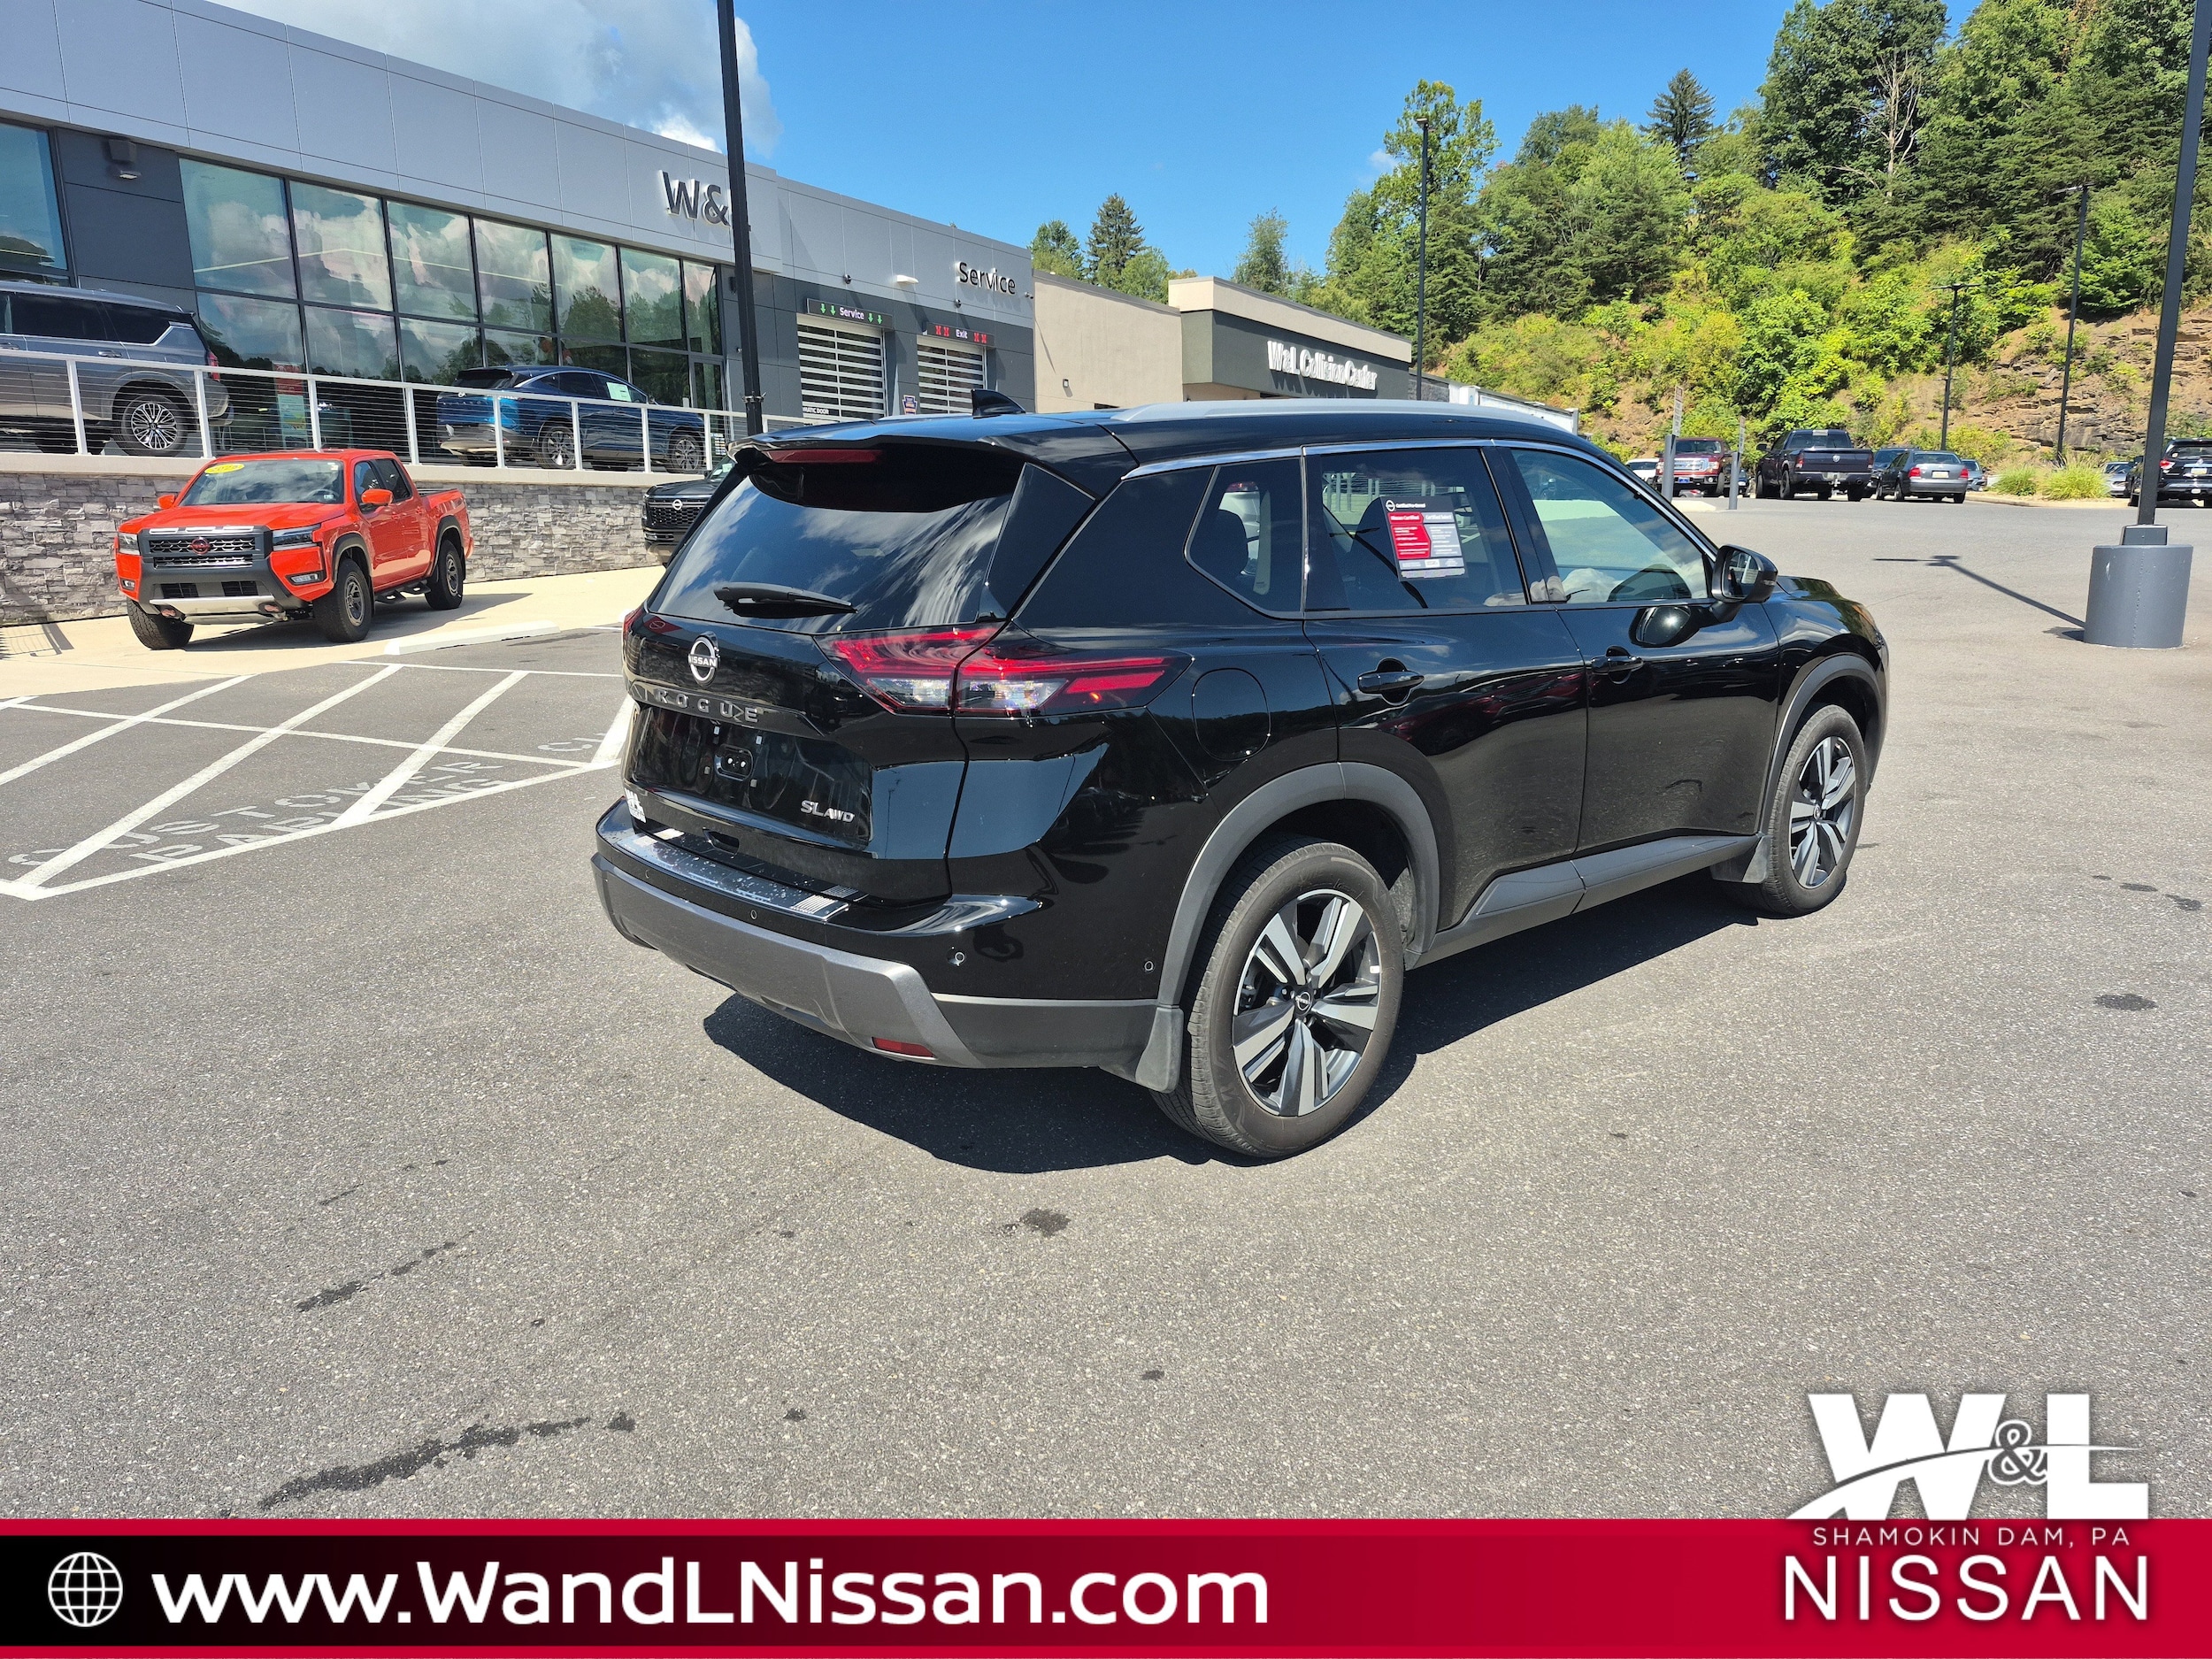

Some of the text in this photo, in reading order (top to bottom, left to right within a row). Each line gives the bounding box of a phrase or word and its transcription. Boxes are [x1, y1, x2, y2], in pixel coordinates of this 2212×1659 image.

[658, 165, 751, 232] W&
[956, 261, 1016, 295] Service
[839, 306, 864, 320] Service
[955, 328, 968, 340] Exit
[1300, 349, 1346, 384] Collision
[655, 688, 758, 723] ROGUE
[800, 800, 856, 823] SL AWD
